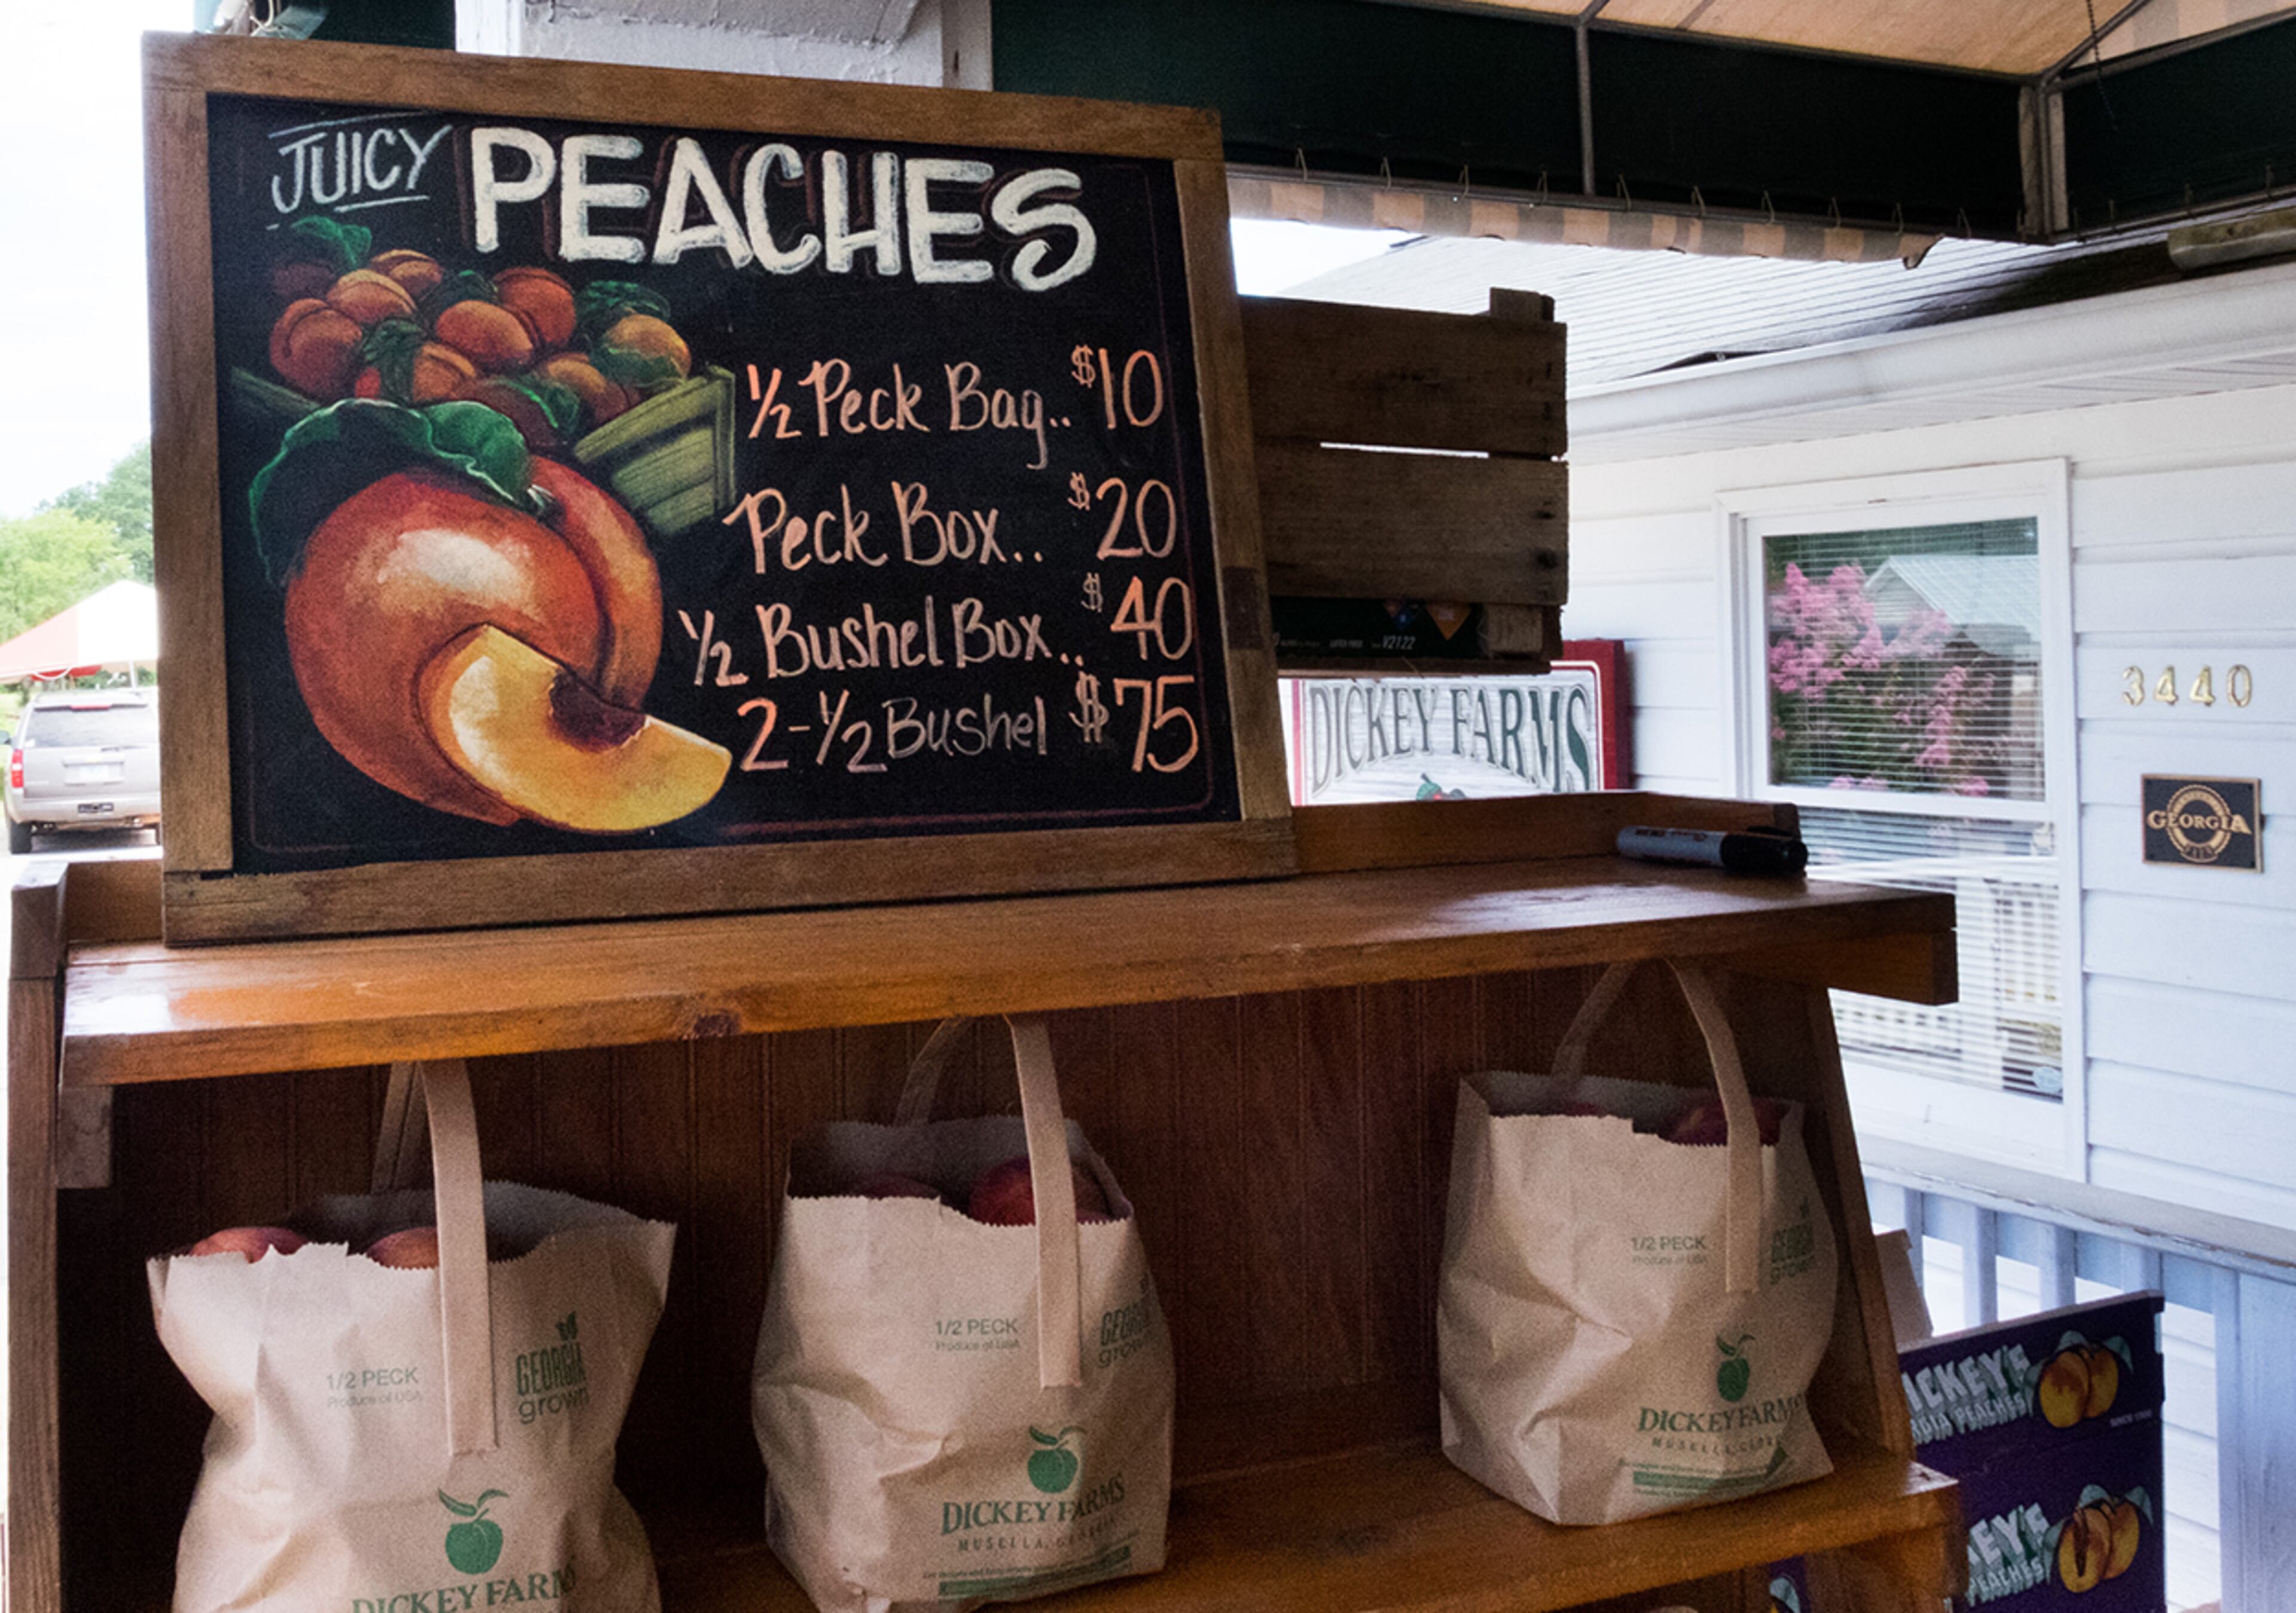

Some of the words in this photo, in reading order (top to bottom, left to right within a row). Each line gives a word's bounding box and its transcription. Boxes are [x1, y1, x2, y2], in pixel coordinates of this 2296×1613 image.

[271, 124, 453, 214] JUICY
[471, 126, 1097, 292] PEACHES
[798, 358, 930, 437] Peck
[1071, 344, 1163, 429] $10
[722, 487, 889, 574] Peck
[1068, 471, 1177, 560] $20
[755, 595, 944, 679] Bushel
[1081, 572, 1193, 661] $40
[2121, 664, 2253, 708] 3440
[882, 694, 1047, 758] Bushel
[1068, 672, 1198, 773] $75
[1309, 684, 1436, 796] DICKEY
[1449, 682, 1592, 793] FARMS
[2147, 810, 2252, 835] GEORGIA
[1659, 1234, 1707, 1251] PECK
[936, 1319, 963, 1335] 1/2
[967, 1318, 1018, 1335] PECK
[326, 1371, 357, 1390] 1/2
[362, 1366, 419, 1388] PECK
[516, 1341, 588, 1396] GEORGIA
[1901, 1343, 2031, 1412] ICKEY'S
[518, 1386, 591, 1425] grown
[1637, 1408, 1735, 1434] DICKEY
[941, 1500, 1052, 1535] DICKEY
[1057, 1471, 1126, 1521] FARMS
